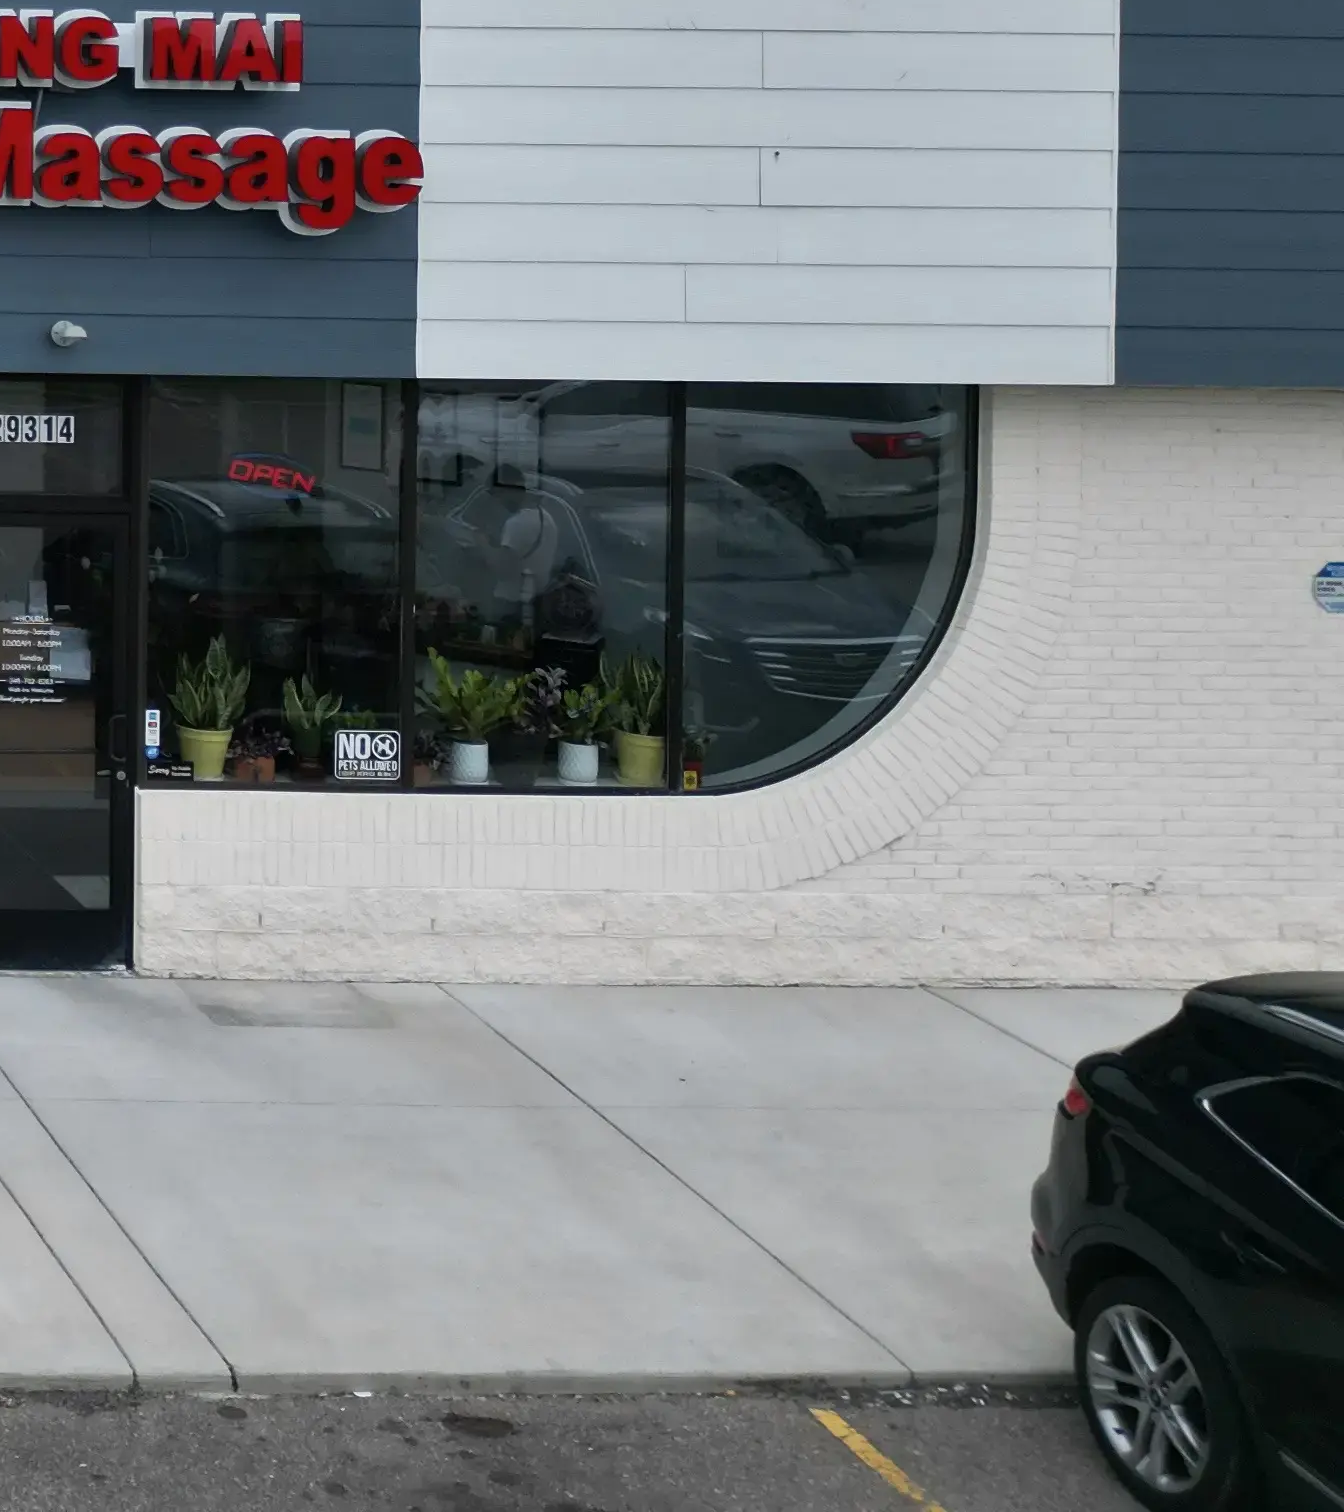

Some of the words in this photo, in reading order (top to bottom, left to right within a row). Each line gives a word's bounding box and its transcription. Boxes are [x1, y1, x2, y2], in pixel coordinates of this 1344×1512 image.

[148, 15, 304, 86] MAI
[228, 458, 316, 493] OPEN
[338, 733, 371, 760] NO
[147, 764, 171, 777] Sorry
[338, 760, 358, 771] PETS
[359, 760, 398, 772] ALLOWED
